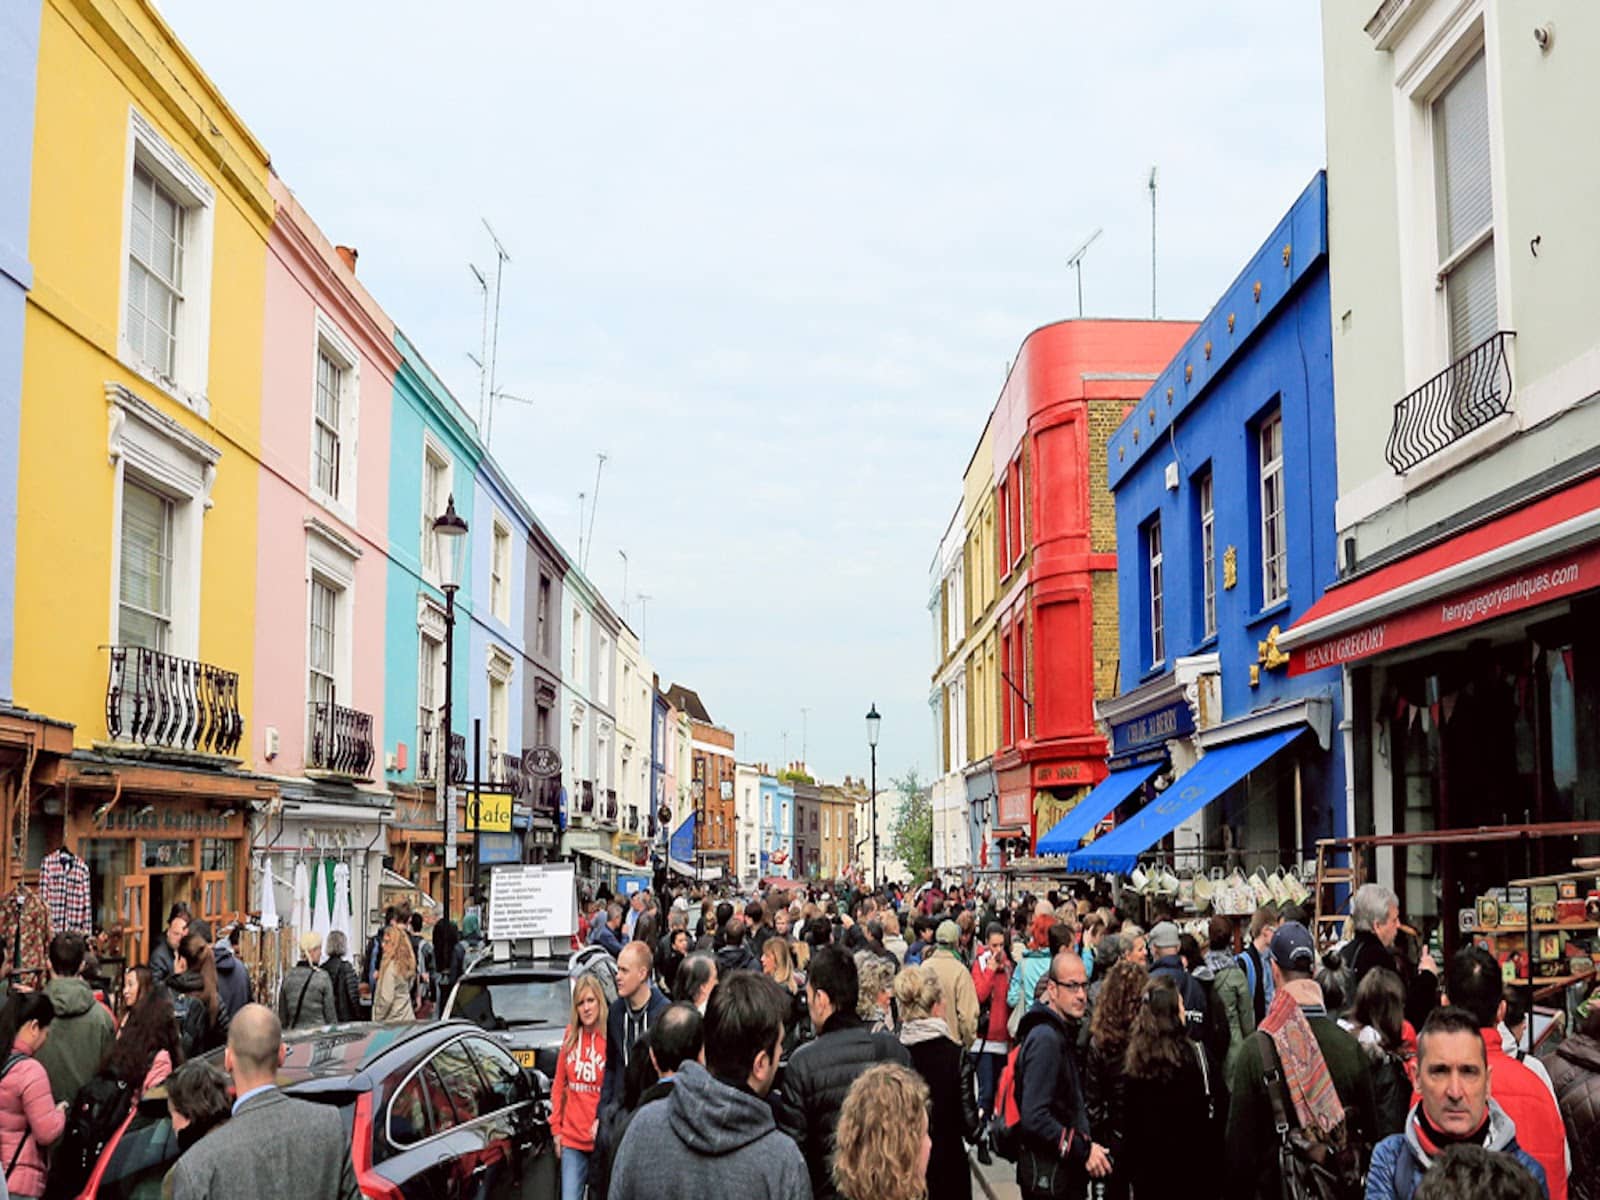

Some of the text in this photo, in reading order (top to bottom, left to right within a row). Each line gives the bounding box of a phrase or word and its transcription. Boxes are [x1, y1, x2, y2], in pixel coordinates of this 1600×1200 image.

[1441, 562, 1579, 623] henrygregoryantiques.com
[1304, 624, 1387, 671] HENRY GREGORY
